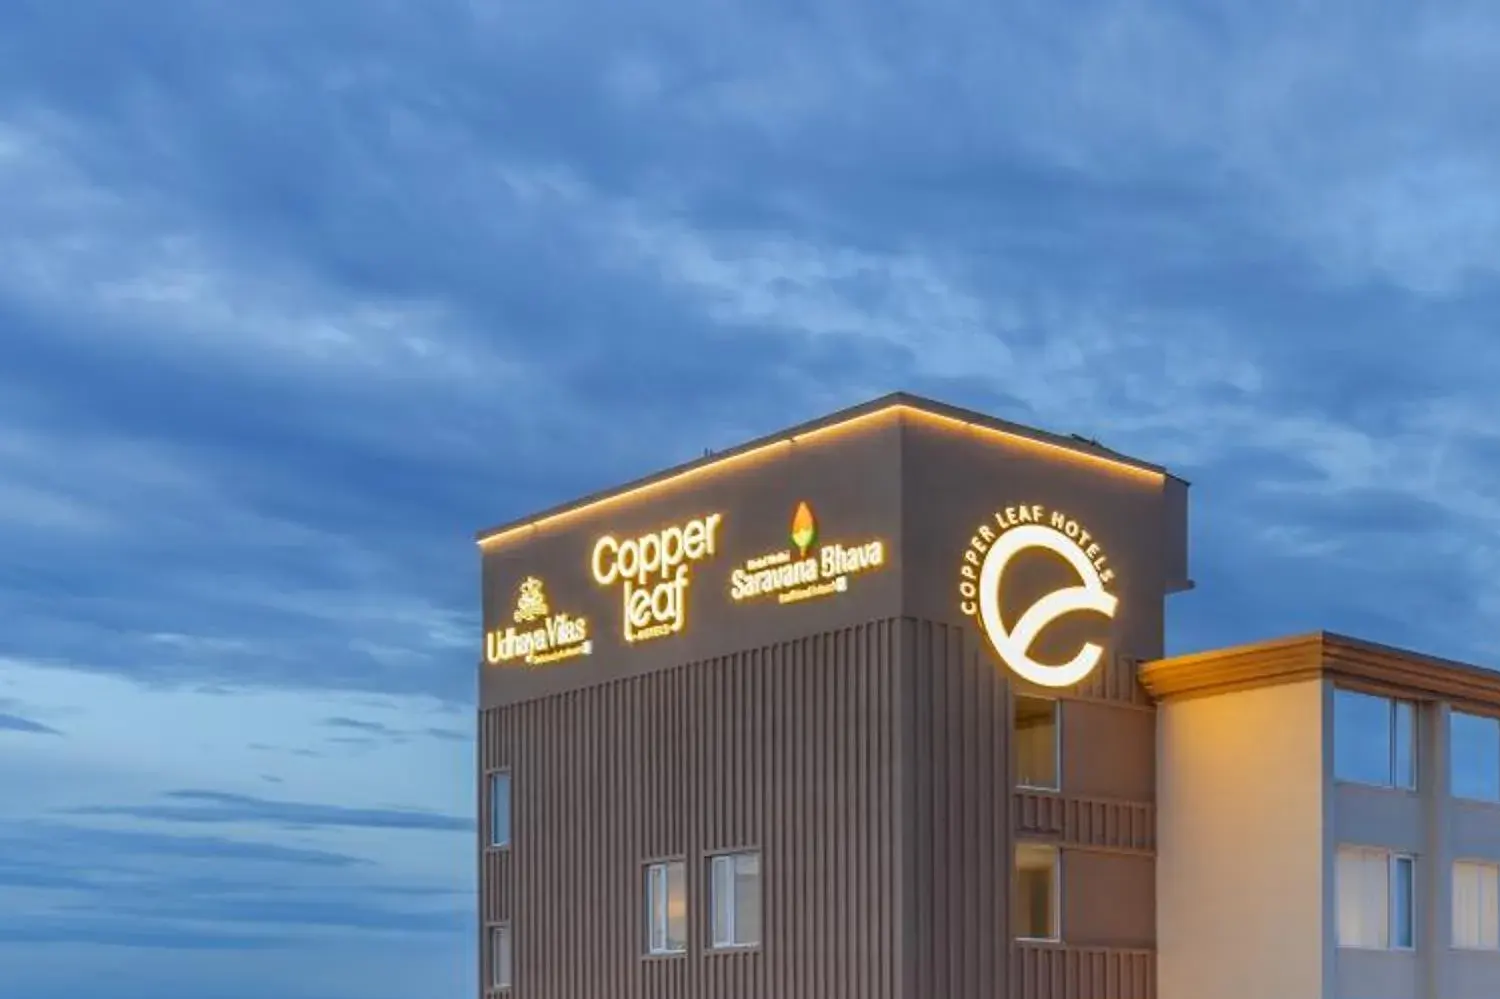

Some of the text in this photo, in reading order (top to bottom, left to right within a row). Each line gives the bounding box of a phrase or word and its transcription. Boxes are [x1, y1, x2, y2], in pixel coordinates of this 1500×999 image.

[592, 513, 721, 585] Copper
[731, 557, 818, 600] Saravana
[821, 541, 883, 577] Bhava
[960, 505, 1116, 615] COPPER LEAF HOTELS
[624, 564, 689, 641] leaf
